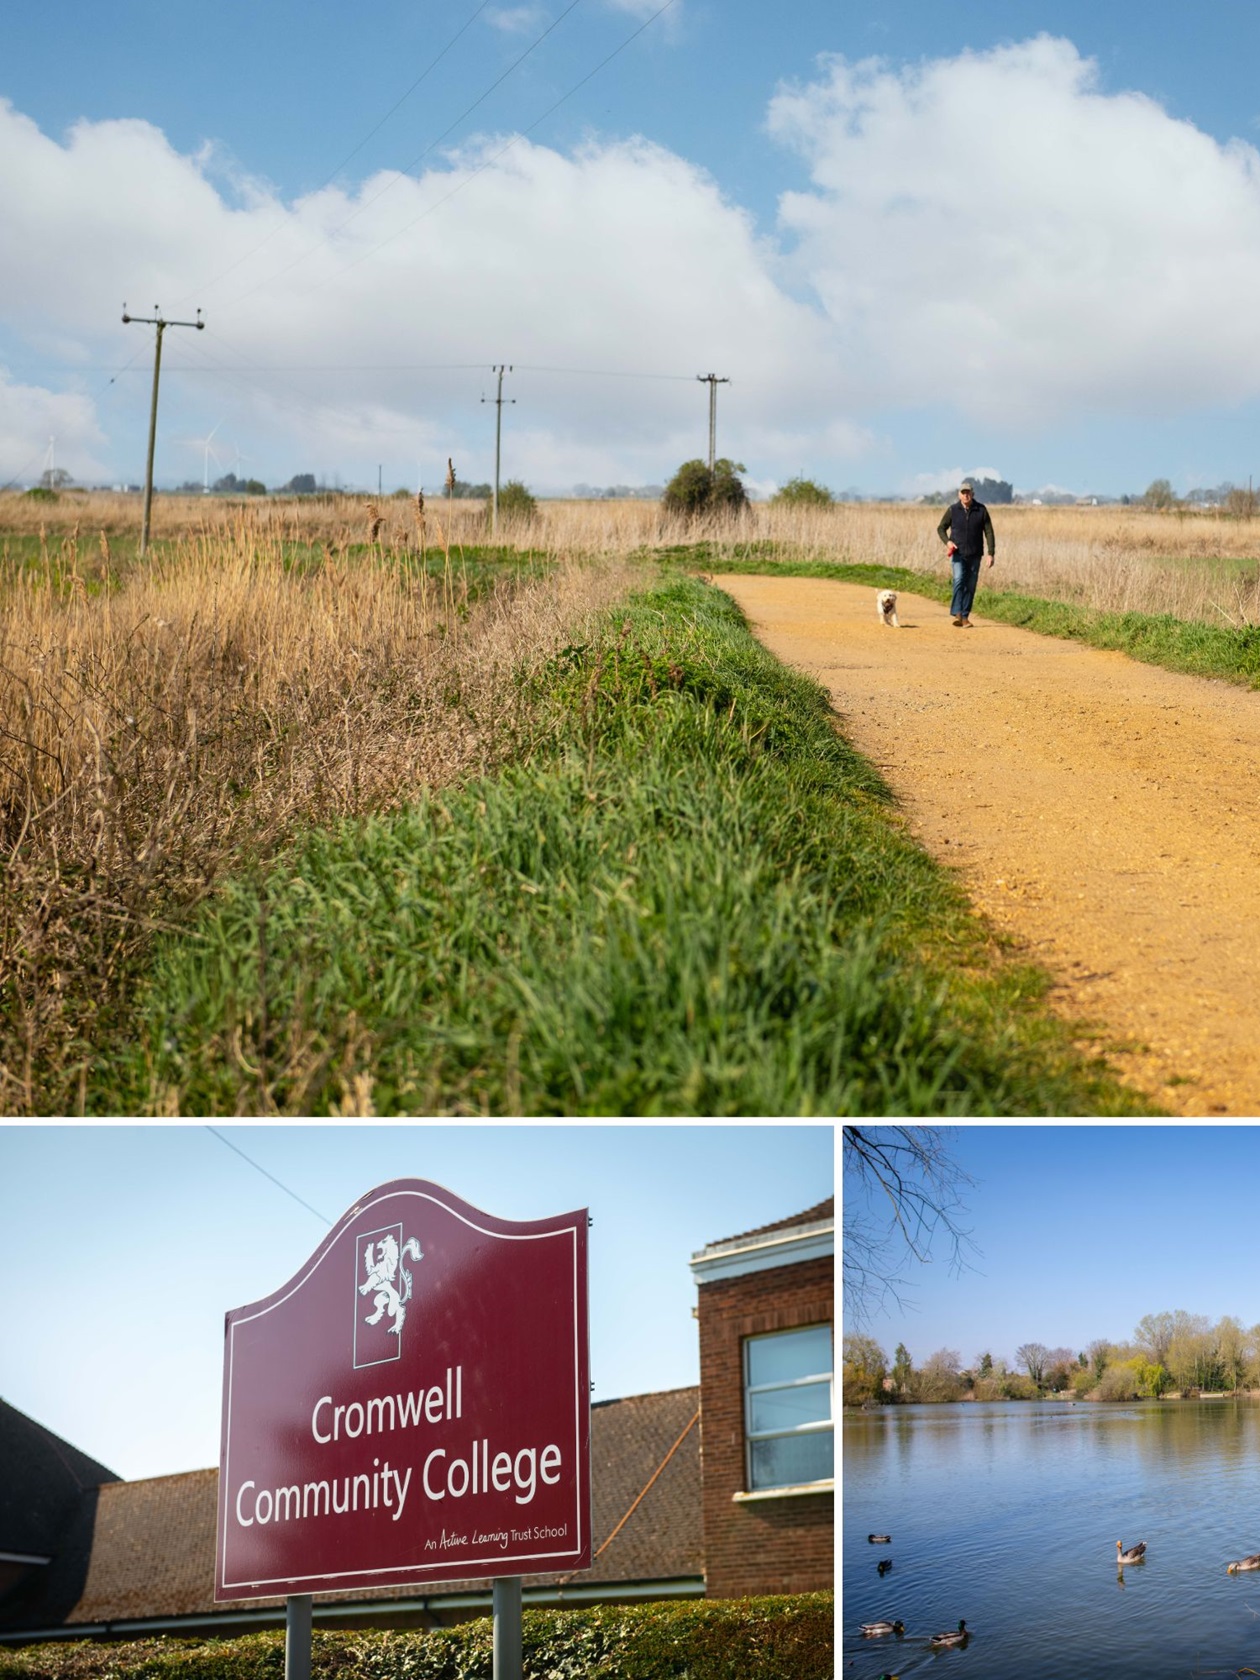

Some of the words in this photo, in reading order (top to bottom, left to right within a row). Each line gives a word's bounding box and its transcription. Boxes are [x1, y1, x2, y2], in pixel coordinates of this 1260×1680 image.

[311, 1366, 462, 1444] Cromwell
[236, 1458, 412, 1527] Community
[422, 1439, 562, 1504] College
[424, 1539, 437, 1550] An
[439, 1529, 469, 1550] Active
[472, 1528, 508, 1549] Learning
[511, 1528, 532, 1541] Trust
[533, 1523, 568, 1540] School
